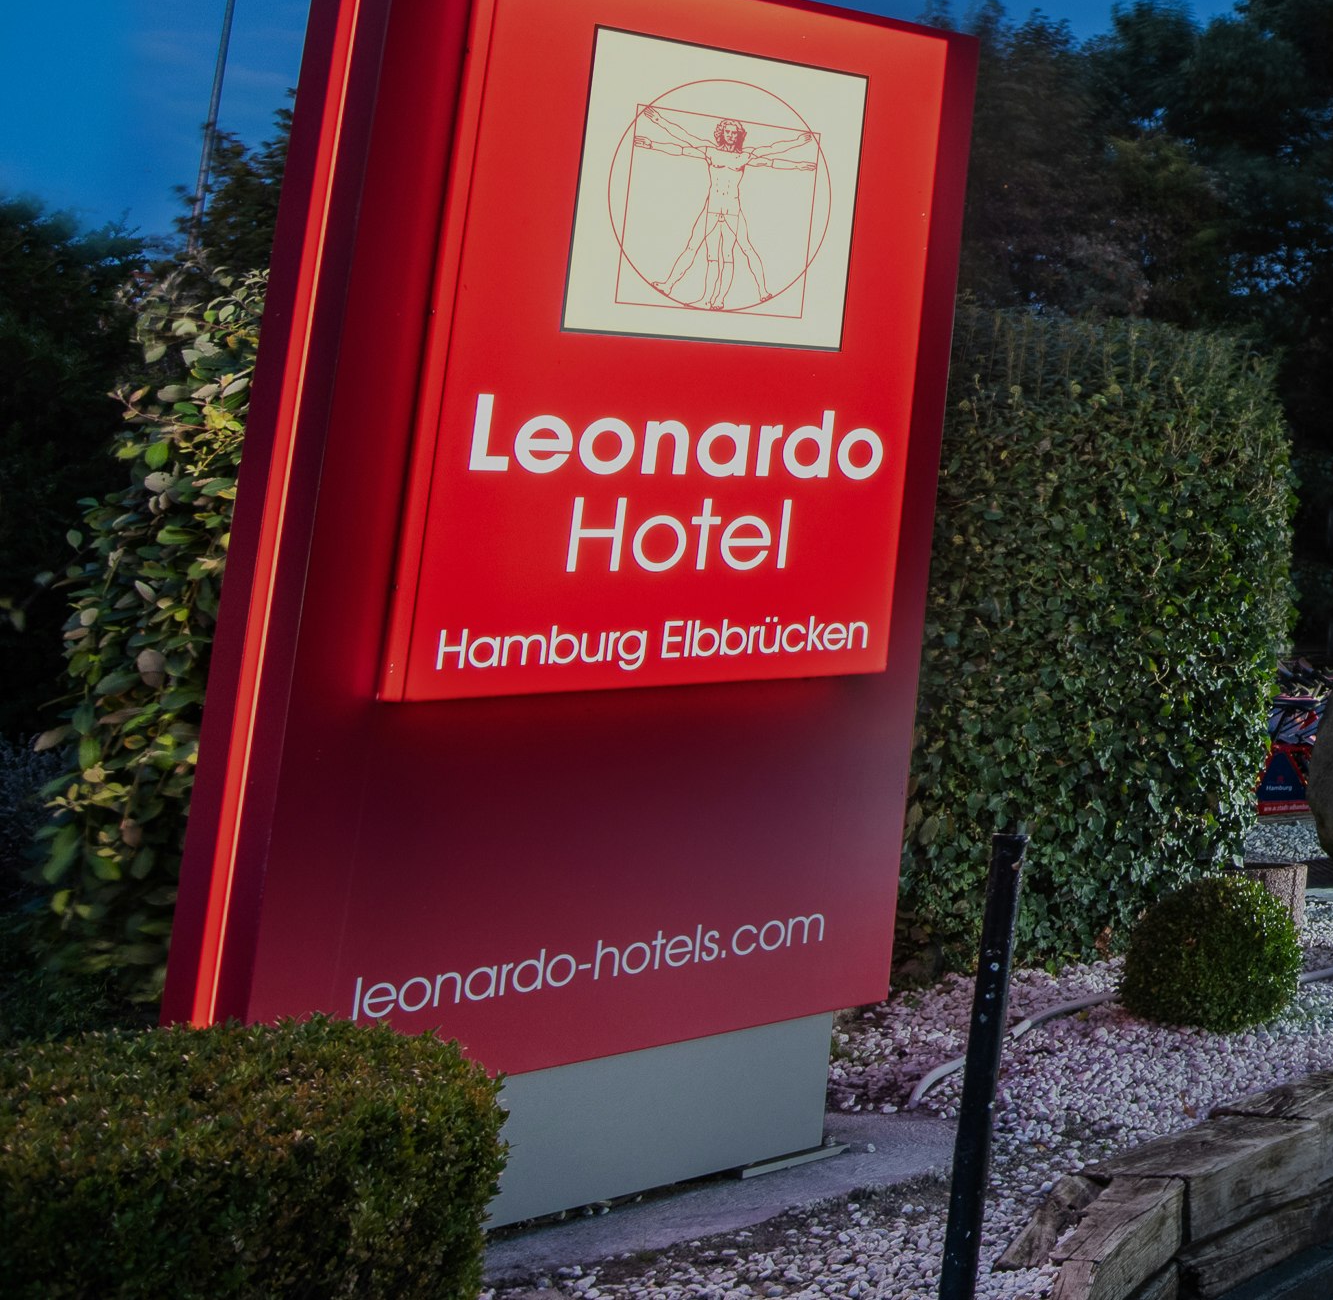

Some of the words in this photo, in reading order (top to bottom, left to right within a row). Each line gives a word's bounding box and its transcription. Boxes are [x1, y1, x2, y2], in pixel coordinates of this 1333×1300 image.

[468, 393, 884, 481] Leonardo
[566, 496, 793, 573] Hotel
[435, 625, 648, 671] Hamburg
[660, 615, 869, 659] Elbbrücken
[1265, 784, 1293, 792] Hamburg
[351, 909, 826, 1021] leonardo-hotels.com
